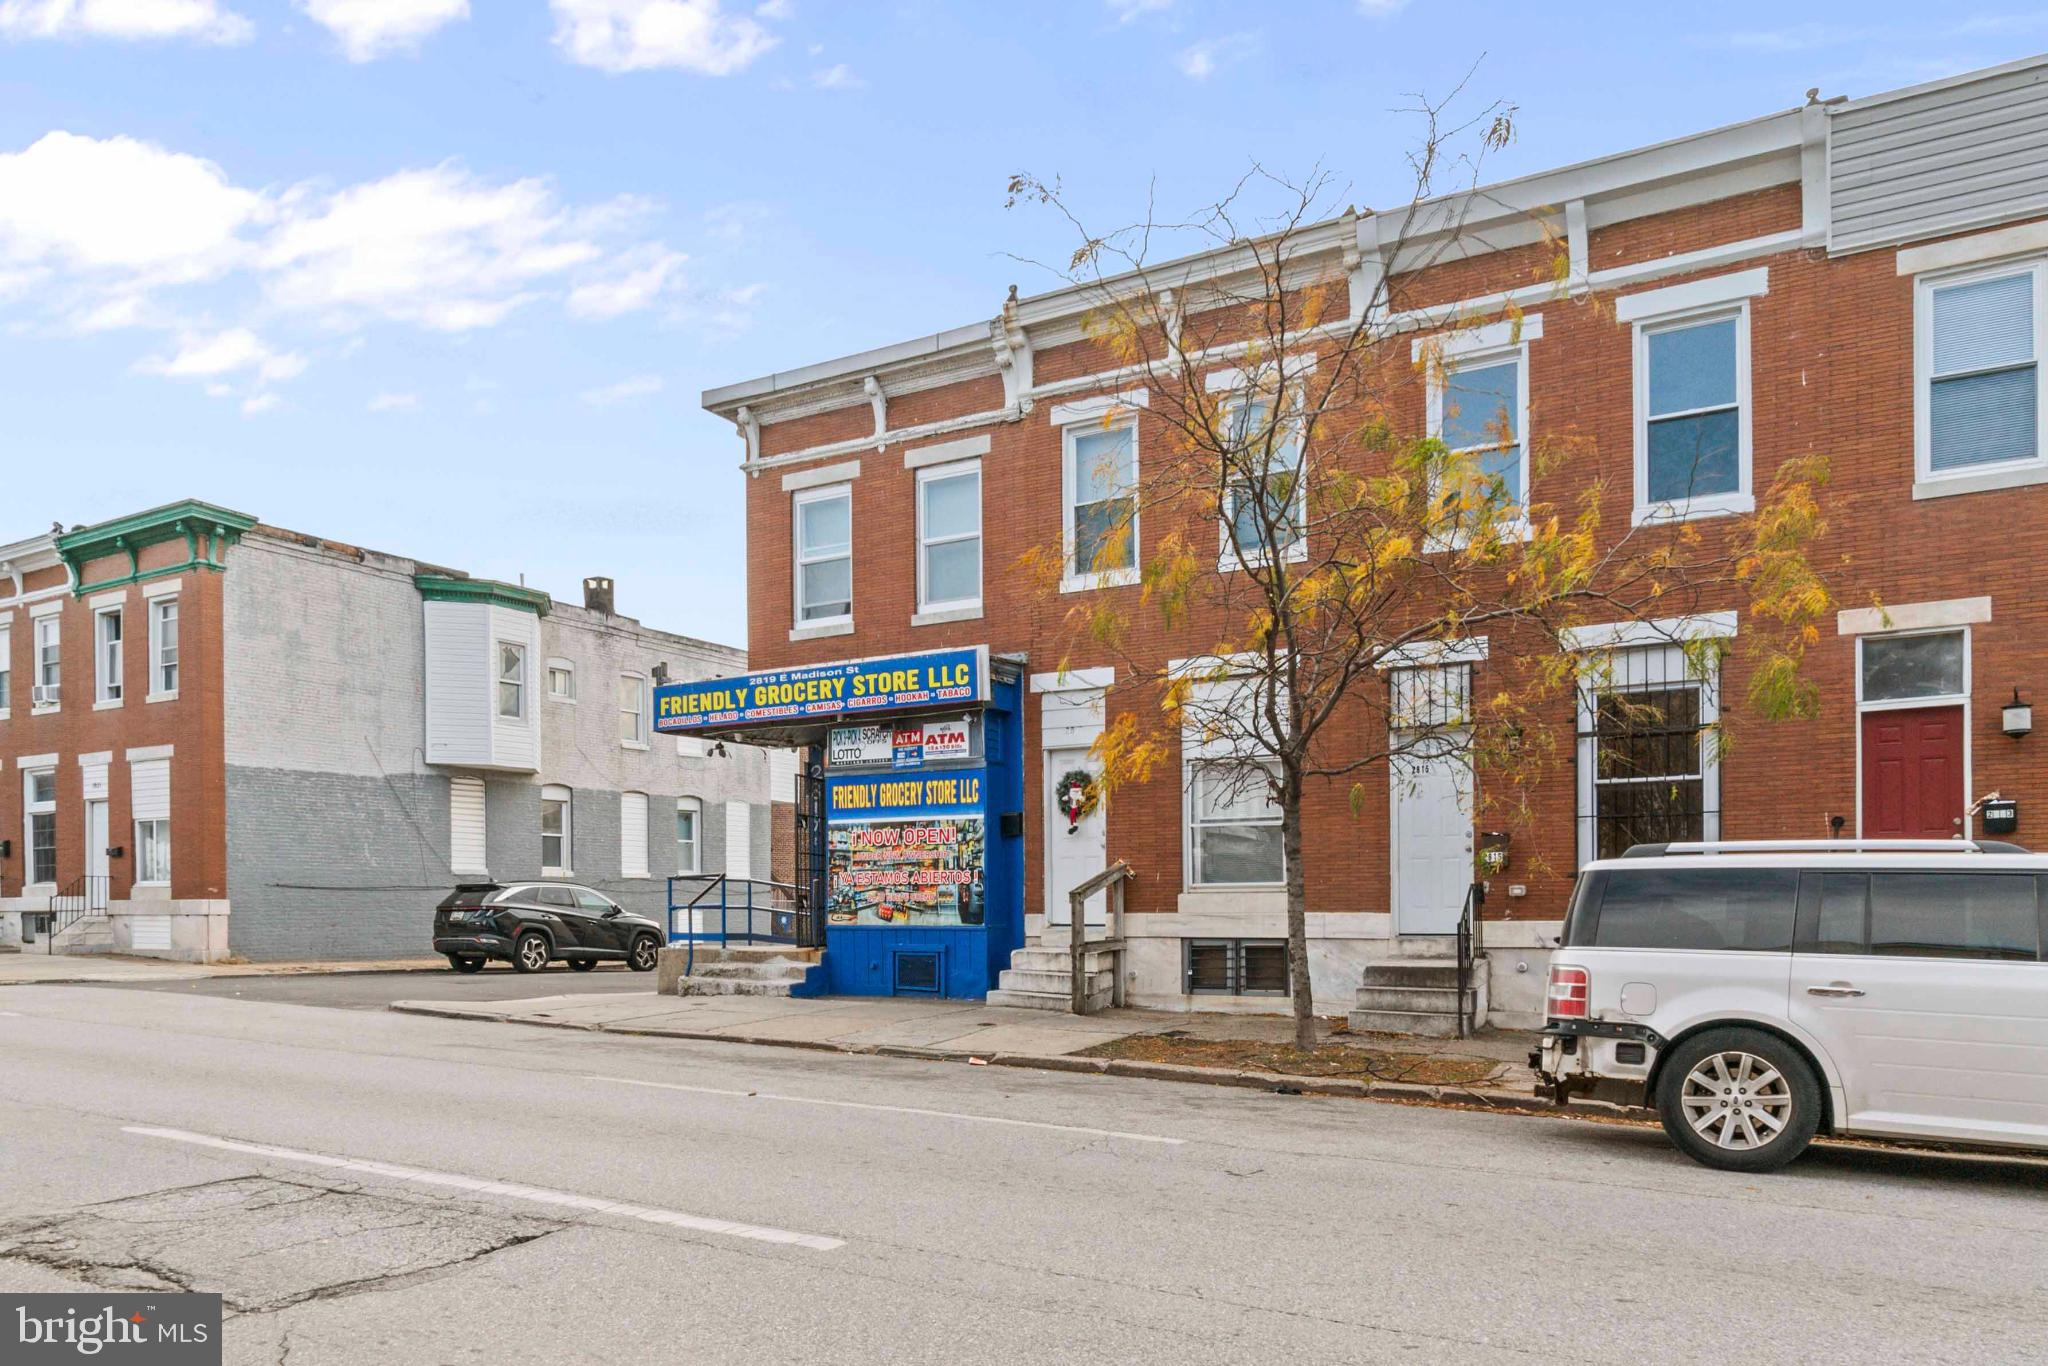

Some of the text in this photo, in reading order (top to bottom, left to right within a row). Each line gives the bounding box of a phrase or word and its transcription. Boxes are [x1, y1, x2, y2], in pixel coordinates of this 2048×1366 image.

[750, 666, 859, 685] 2819 E Madison St
[660, 664, 969, 716] FRIENDLY GROCERY STORE LLC
[659, 688, 970, 726] BOCADILLOS HELADO COMESTIBLES CAMISAS CIGARROS HOOKAH TABACO
[896, 732, 920, 744] ATM
[925, 732, 965, 745] ATM
[833, 748, 861, 760] LOTTO
[833, 778, 979, 809] FRIENDLY GROCERY STORE LLC
[904, 827, 957, 844] OPEN!
[857, 872, 909, 885] ESTAMOS
